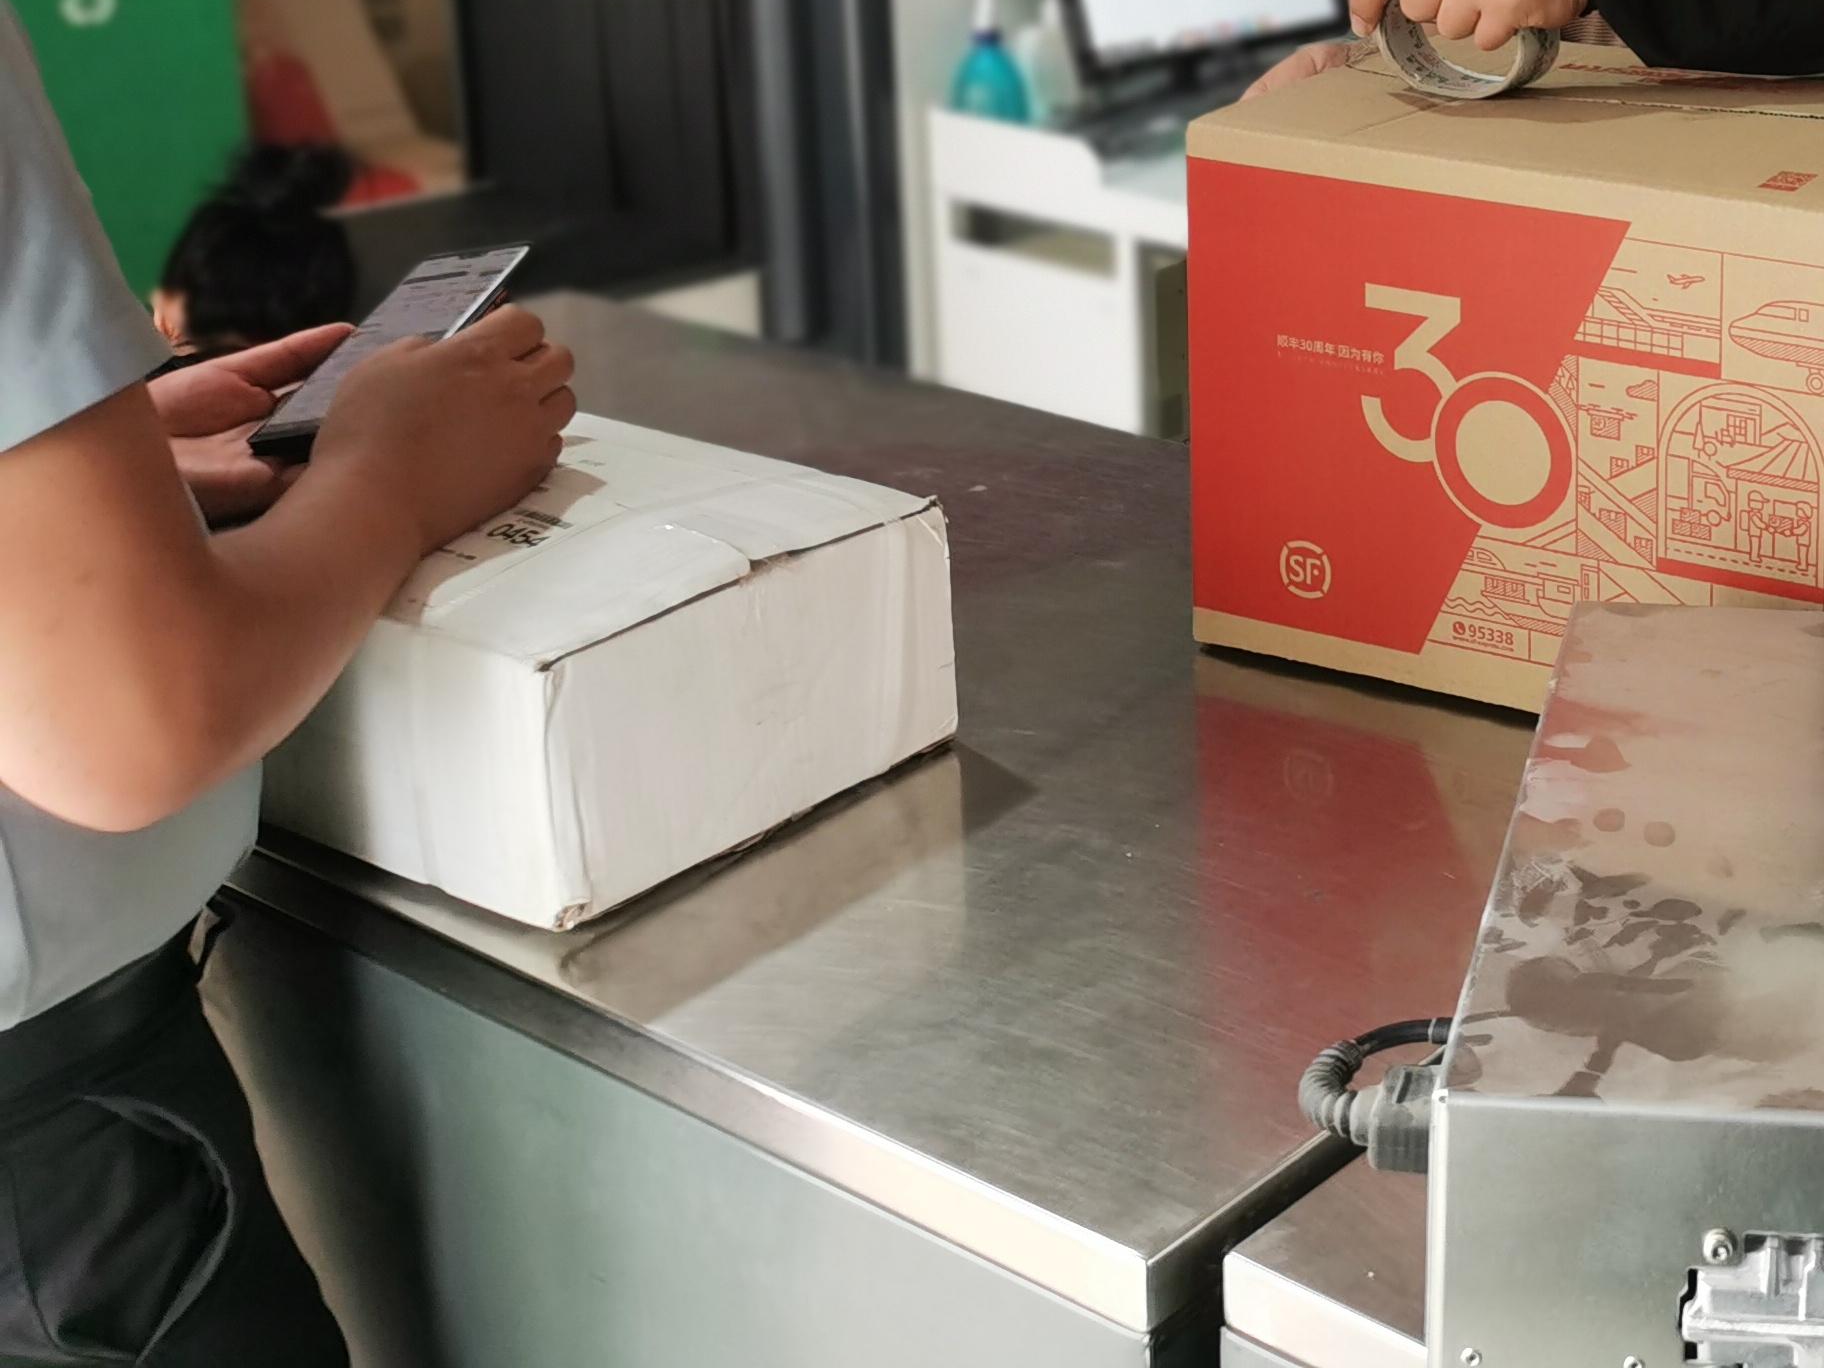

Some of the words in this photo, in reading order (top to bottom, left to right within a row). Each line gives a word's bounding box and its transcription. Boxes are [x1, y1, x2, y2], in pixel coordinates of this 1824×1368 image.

[1337, 344, 1385, 365] 因为有你
[1361, 282, 1577, 529] 30
[487, 523, 551, 549] 0454
[1467, 623, 1515, 646] 95338
